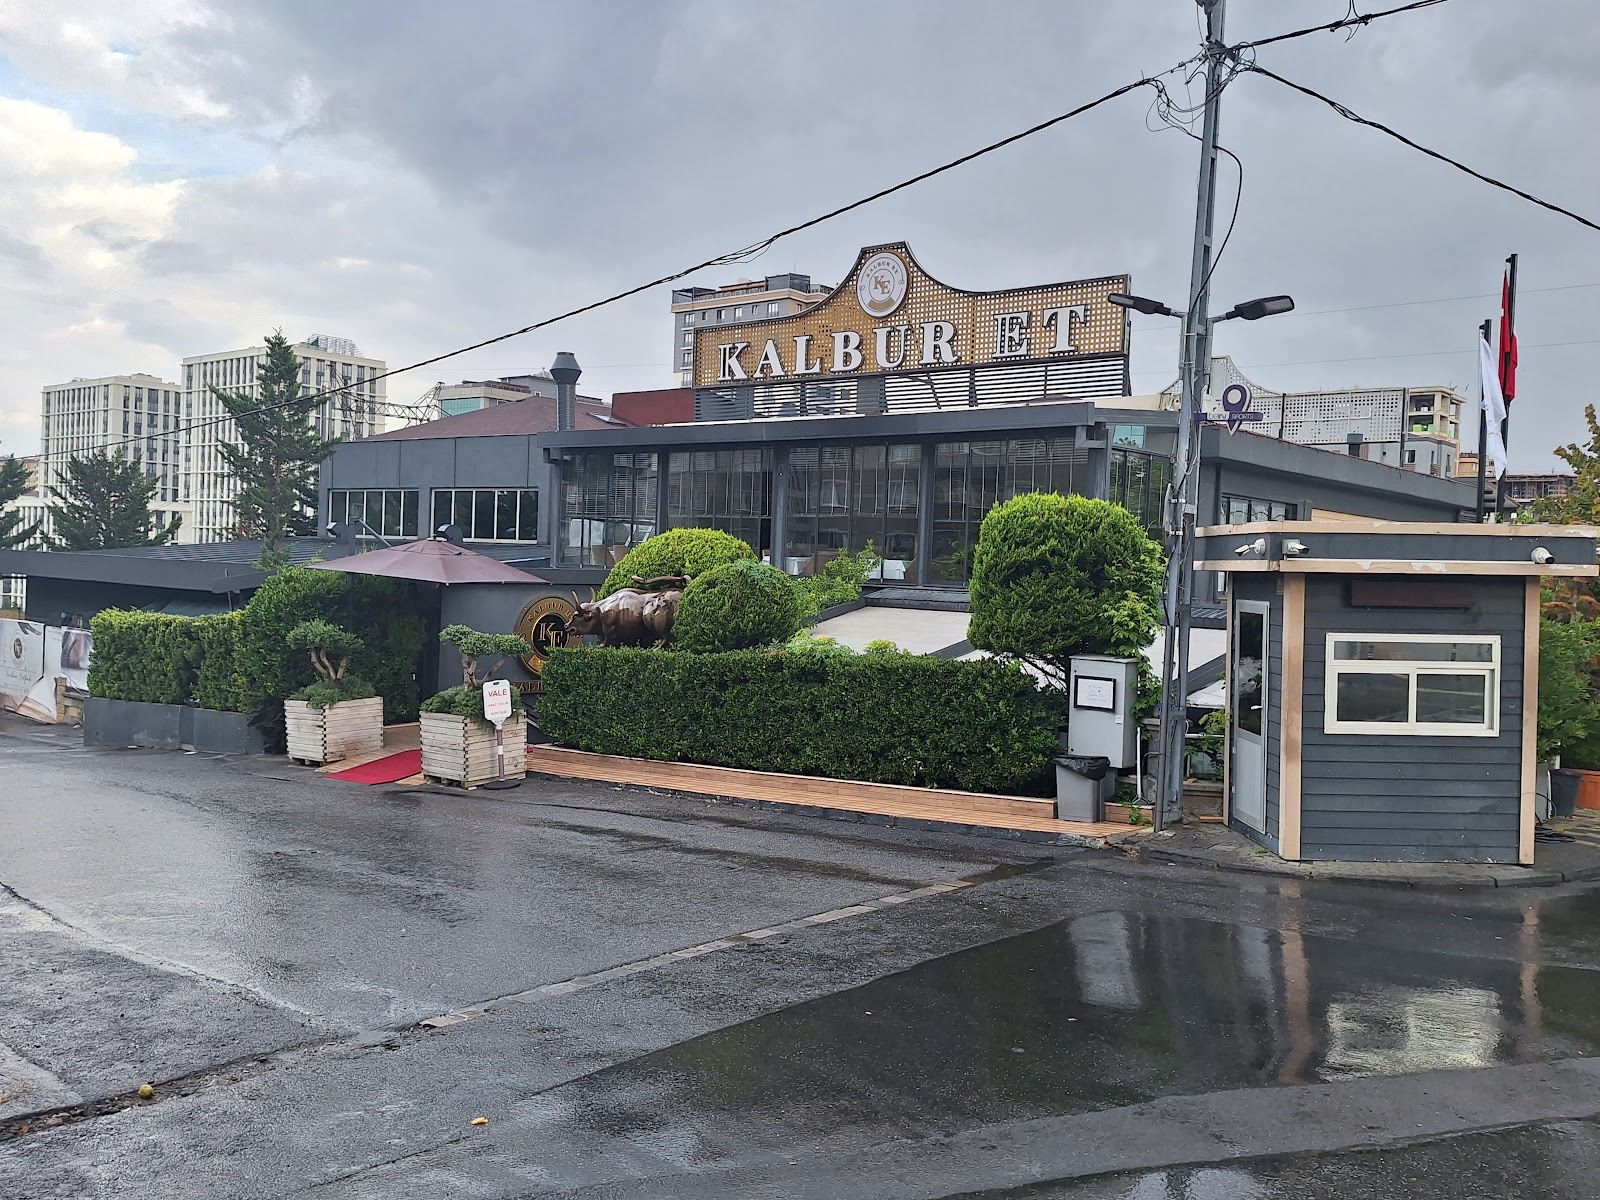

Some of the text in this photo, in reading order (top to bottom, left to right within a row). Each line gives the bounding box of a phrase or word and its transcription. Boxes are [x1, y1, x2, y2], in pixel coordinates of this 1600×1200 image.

[866, 261, 890, 278] KALBUR
[873, 275, 890, 294] KE
[717, 304, 1089, 382] KALBUR ET
[488, 688, 508, 698] VALE
